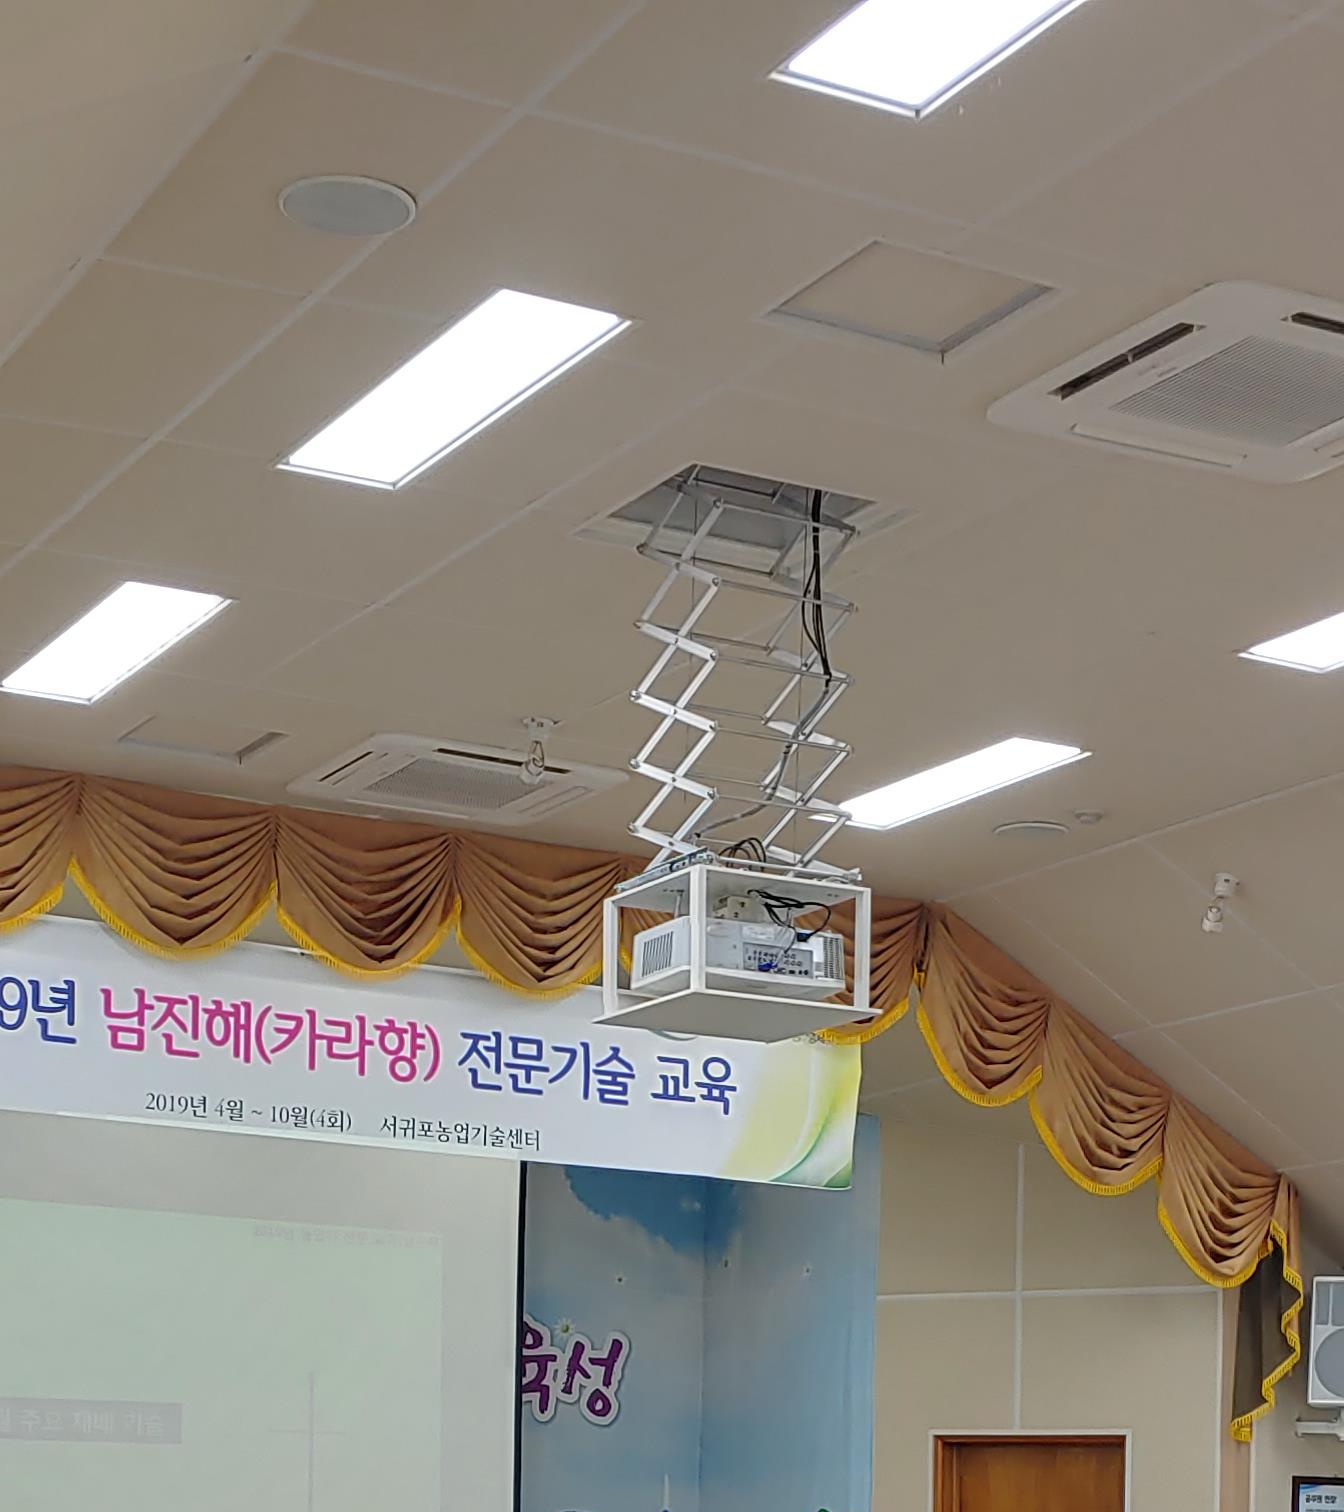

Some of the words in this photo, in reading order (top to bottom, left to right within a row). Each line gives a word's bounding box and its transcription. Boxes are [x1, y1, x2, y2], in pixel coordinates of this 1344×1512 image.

[100, 987, 440, 1083] 남진해(카라향)
[458, 1031, 636, 1106] 전문기술
[650, 1055, 737, 1115] 교육
[144, 1092, 208, 1119] 2019년
[214, 1096, 244, 1122] 4월
[270, 1105, 353, 1133] 10월(4회)
[379, 1115, 540, 1152] 서귀포농업기술센터
